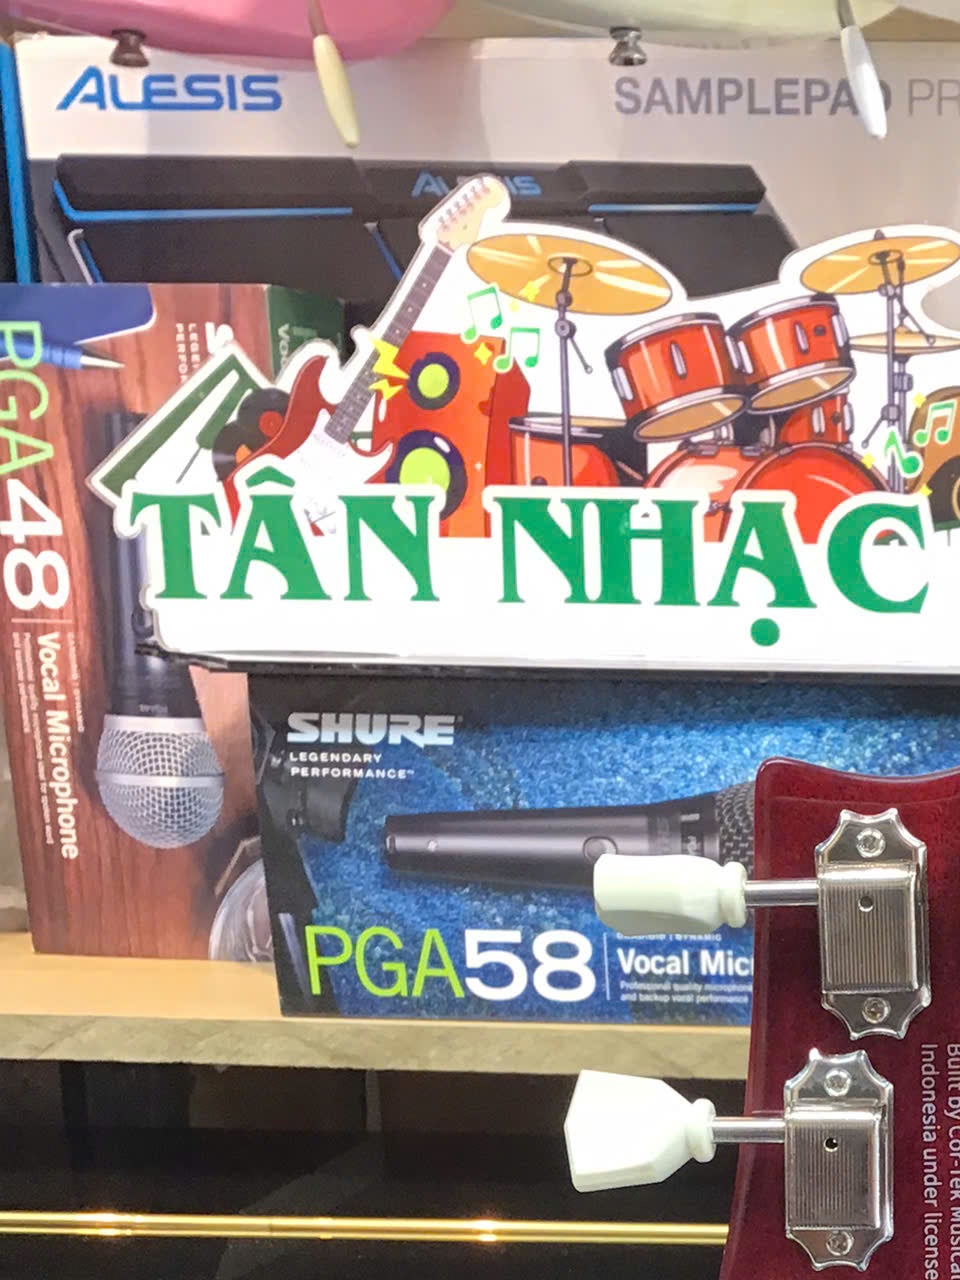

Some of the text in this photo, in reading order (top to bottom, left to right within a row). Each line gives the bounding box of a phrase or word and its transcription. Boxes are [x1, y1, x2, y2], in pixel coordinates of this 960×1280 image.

[56, 65, 282, 111] ALESIS
[0, 321, 71, 610] PGA48
[130, 465, 440, 601] TÂN
[495, 495, 931, 647] NHẠC
[37, 632, 67, 701] Vocal
[287, 711, 456, 749] SHURE
[289, 752, 382, 763] LEGENDARY
[46, 710, 79, 859] Microphone
[305, 925, 597, 1002] PGA58
[617, 948, 755, 976] Vocal Mic
[921, 1044, 941, 1142] Indonesia
[923, 1148, 943, 1208] under
[924, 1212, 943, 1280] license
